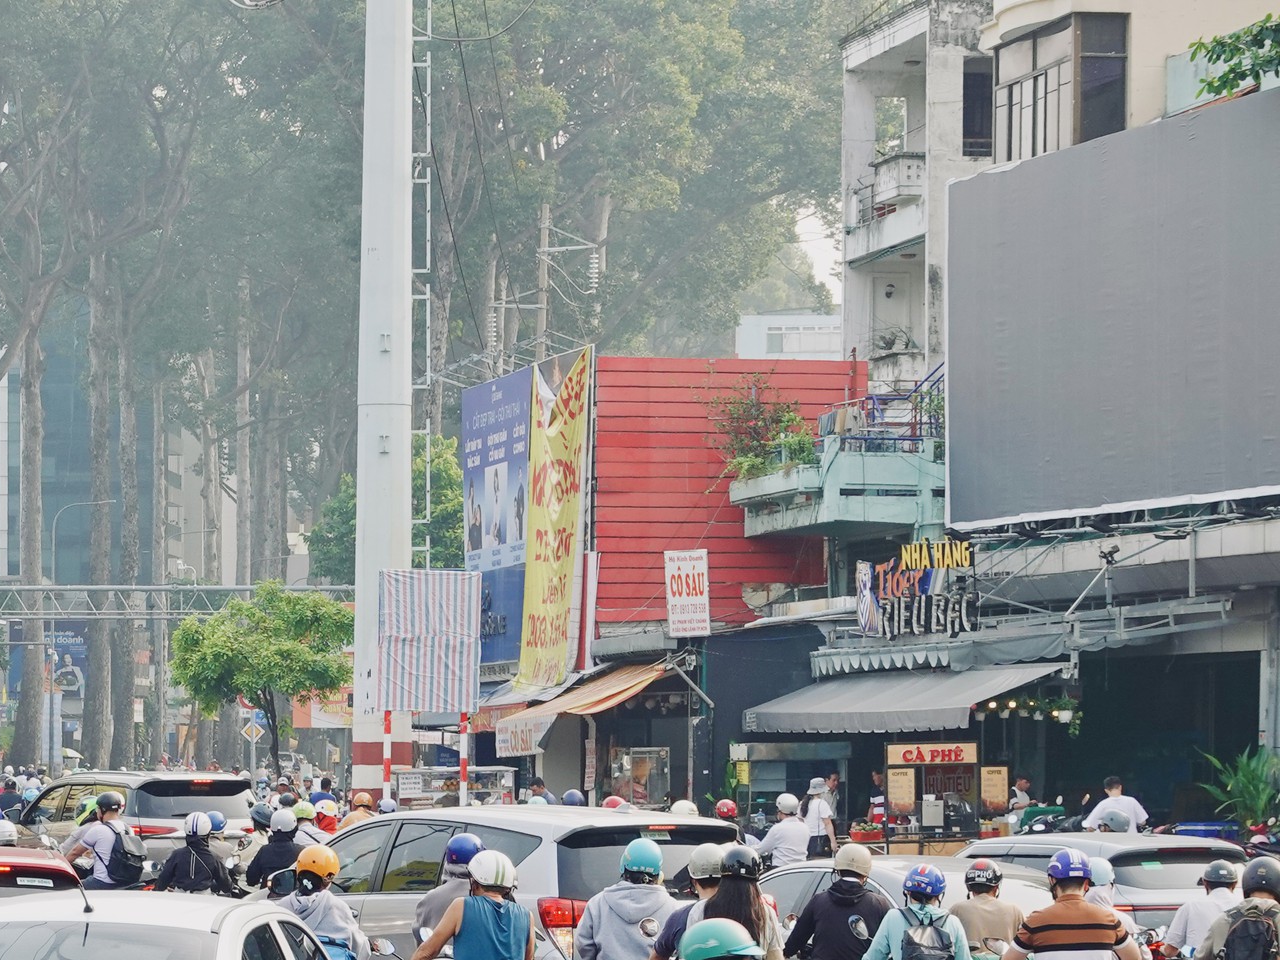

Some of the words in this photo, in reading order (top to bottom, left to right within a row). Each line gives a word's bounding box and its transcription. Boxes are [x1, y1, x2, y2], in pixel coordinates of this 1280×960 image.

[901, 537, 930, 570] NHÀ
[933, 535, 971, 569] HÀNG
[670, 565, 684, 598] CÔ
[685, 565, 705, 598] SÁU
[57, 635, 84, 644] doanh
[901, 746, 926, 763] CÀ
[929, 745, 965, 763] PHÊ
